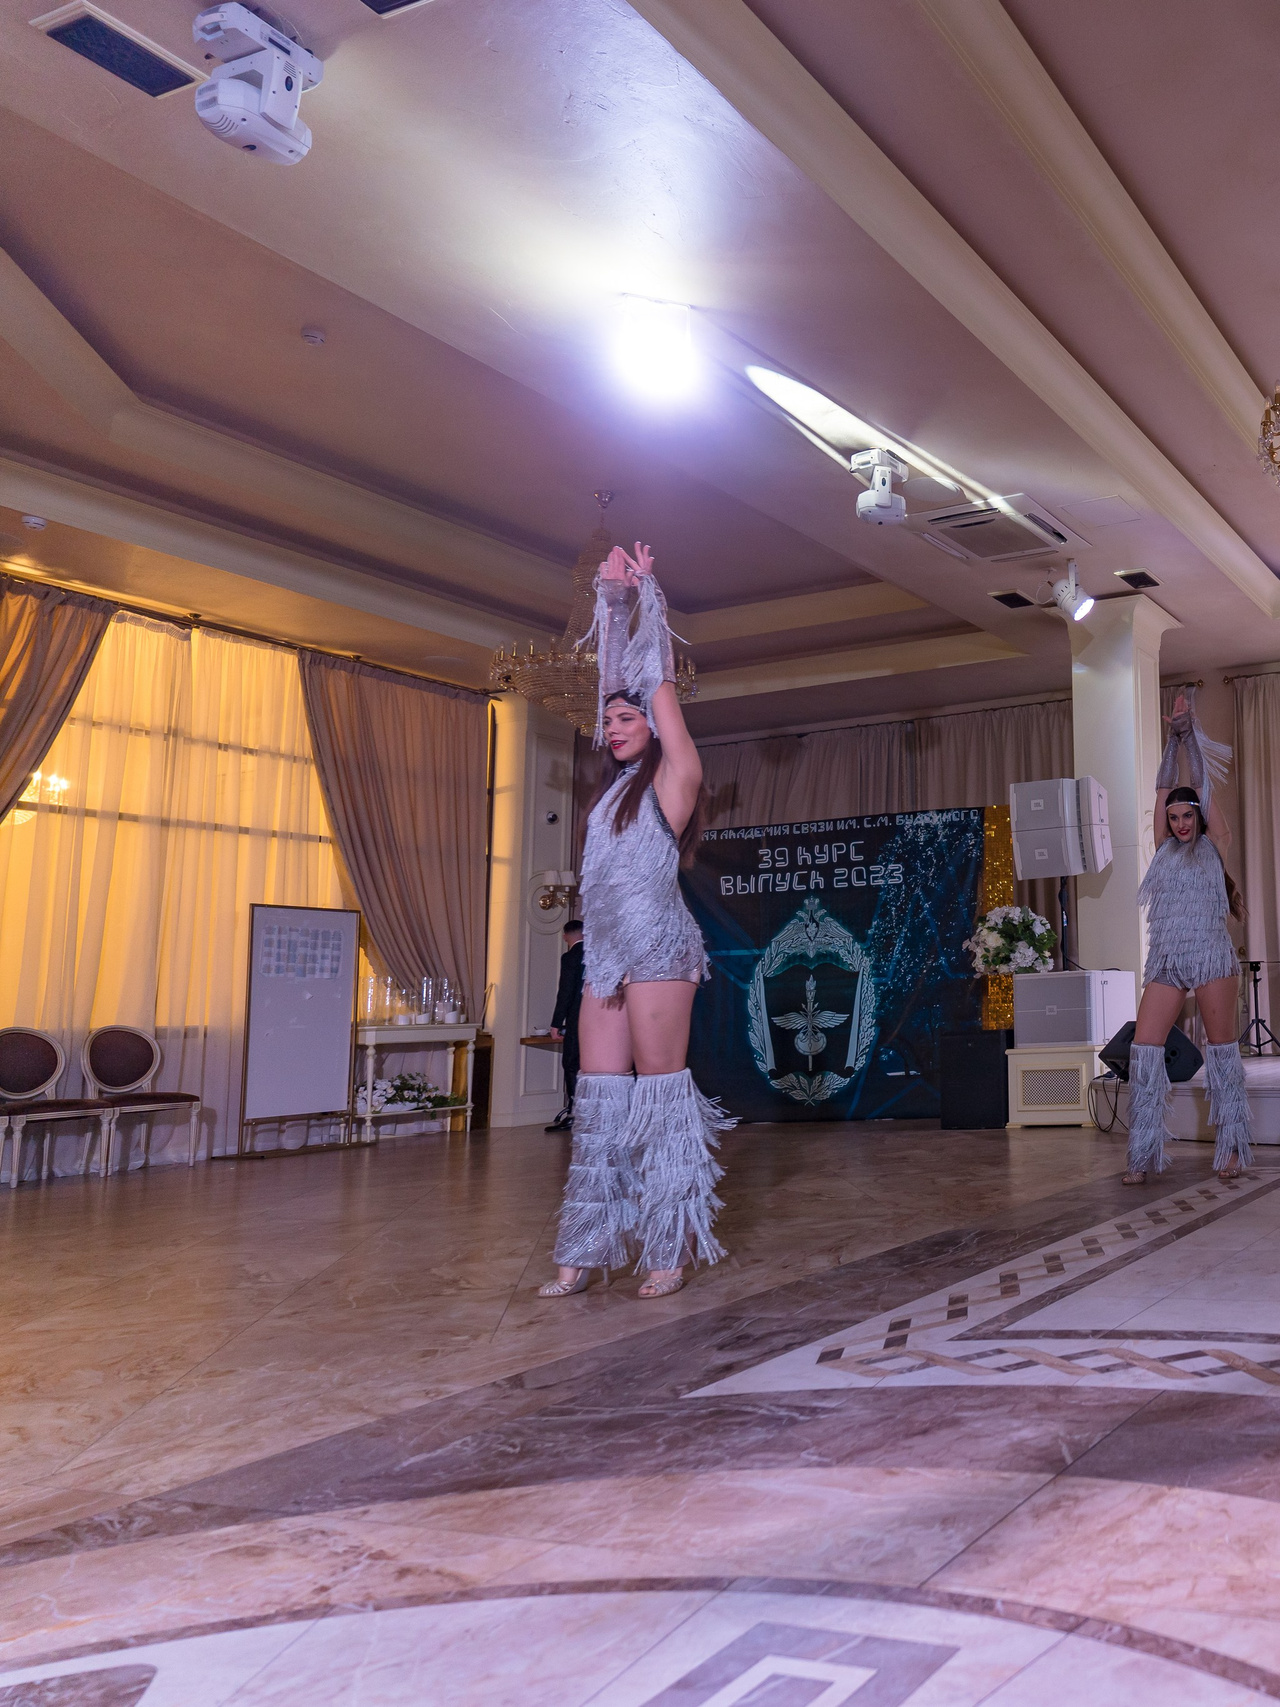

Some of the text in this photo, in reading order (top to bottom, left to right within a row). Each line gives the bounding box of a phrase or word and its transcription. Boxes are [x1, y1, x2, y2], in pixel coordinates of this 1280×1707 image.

[701, 830, 718, 841] АЯ
[720, 825, 790, 840] АКАДЕМИЯ
[792, 821, 834, 835] СВЯЗИ
[836, 818, 860, 830] ИМ.
[863, 816, 892, 828] С.М.
[758, 841, 864, 869] 39 КУРС
[720, 864, 904, 895] ВЫПУСК 2023
